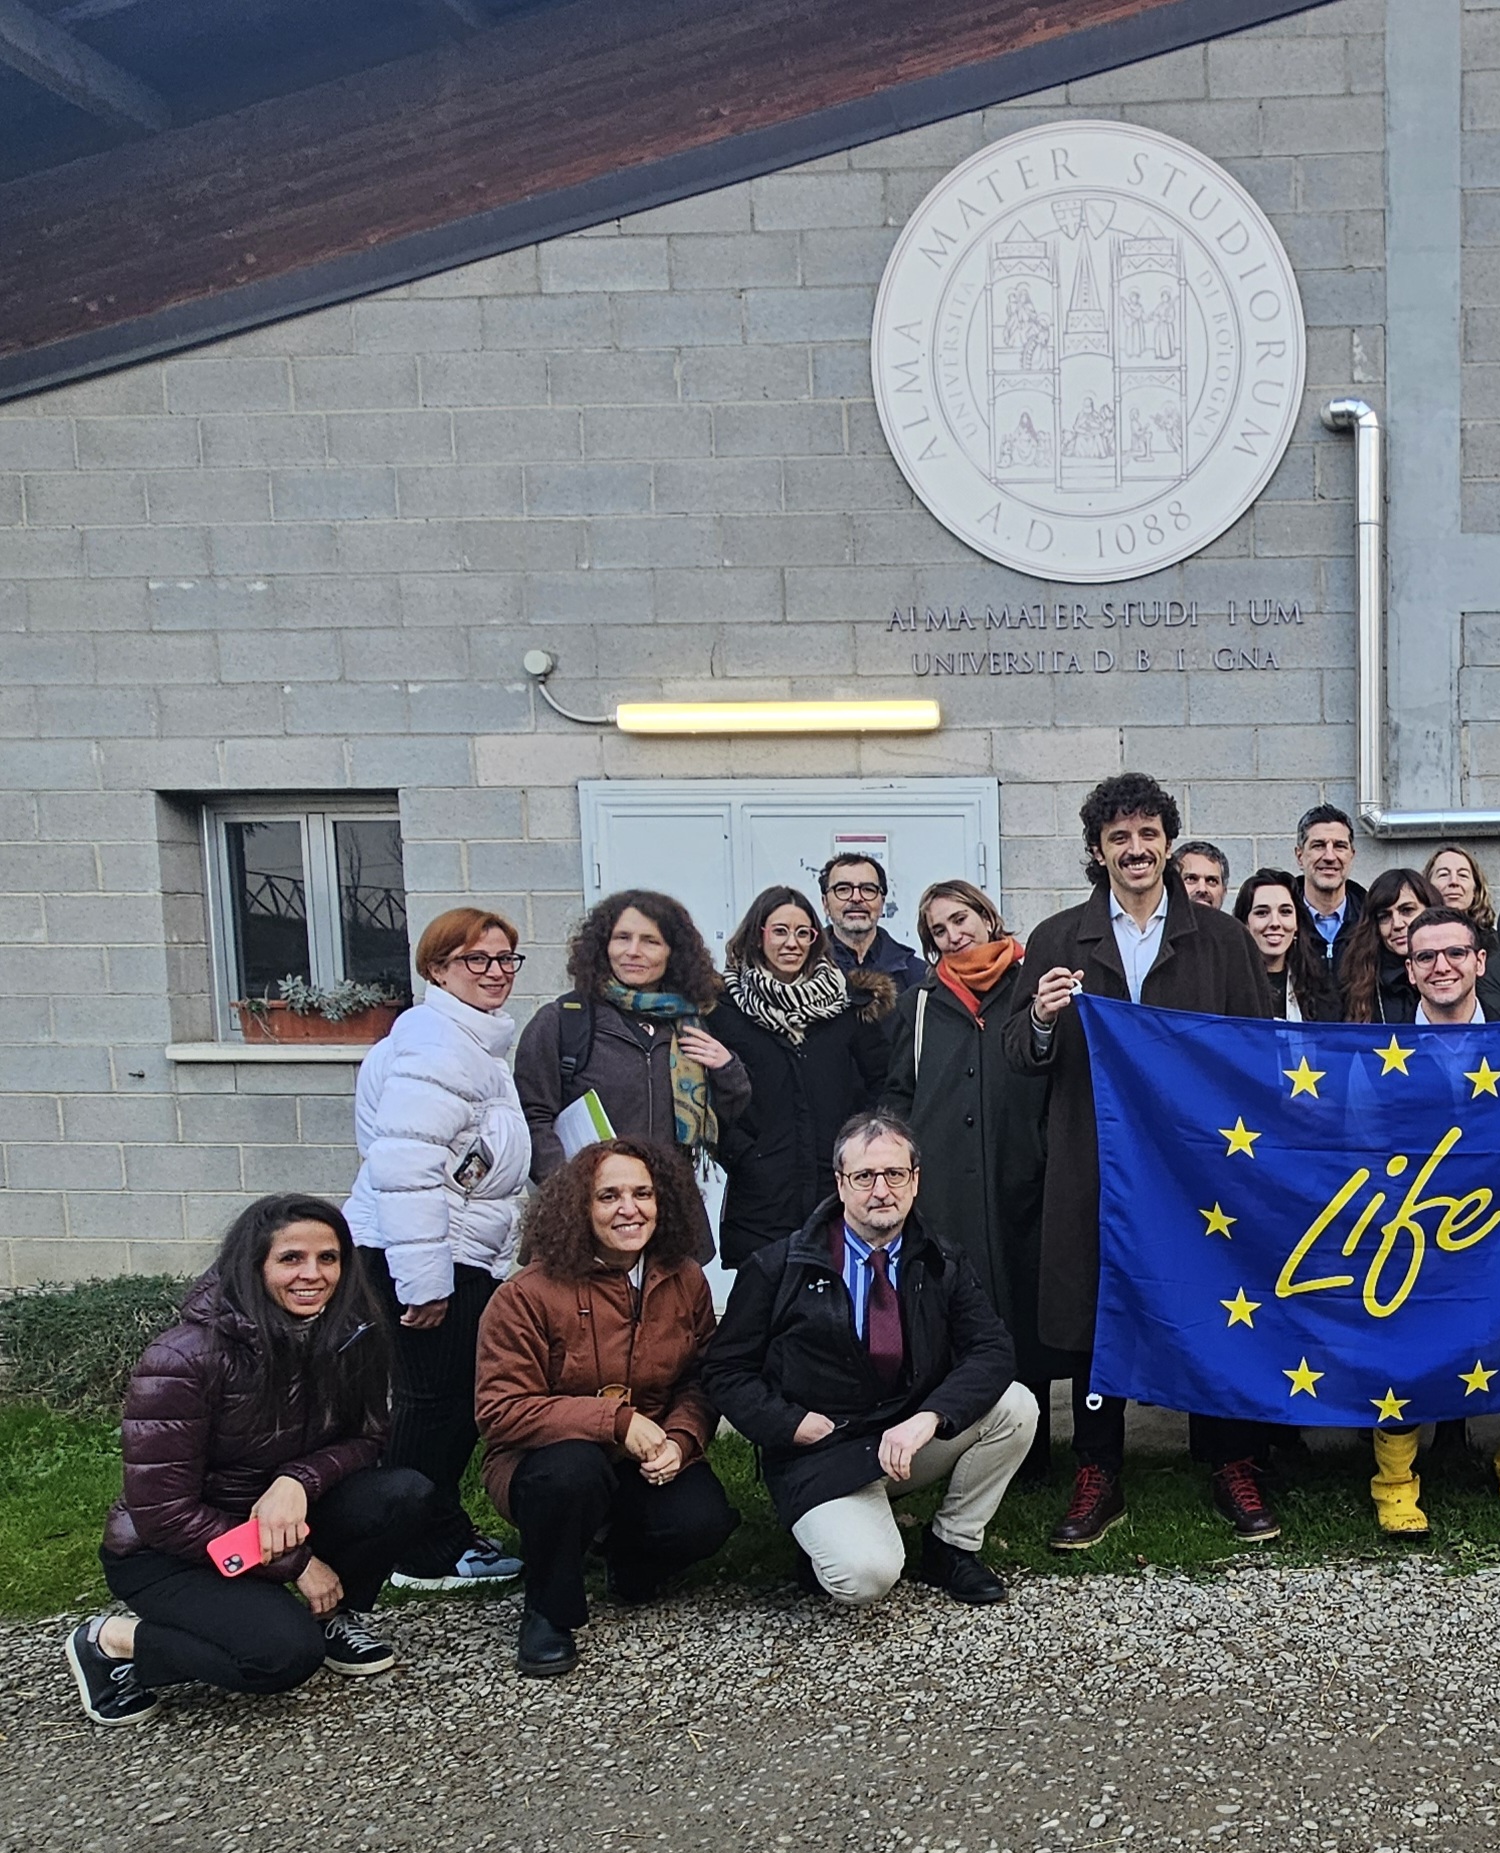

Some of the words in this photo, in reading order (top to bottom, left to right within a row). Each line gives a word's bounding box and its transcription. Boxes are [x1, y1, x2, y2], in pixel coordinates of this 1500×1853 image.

[919, 147, 1080, 270] MATER
[1127, 152, 1287, 459] STUDIORUM
[1196, 270, 1220, 299] DI
[892, 318, 947, 464] ALMA
[1194, 312, 1232, 438] BOLOGNA
[1096, 500, 1191, 558] 1088
